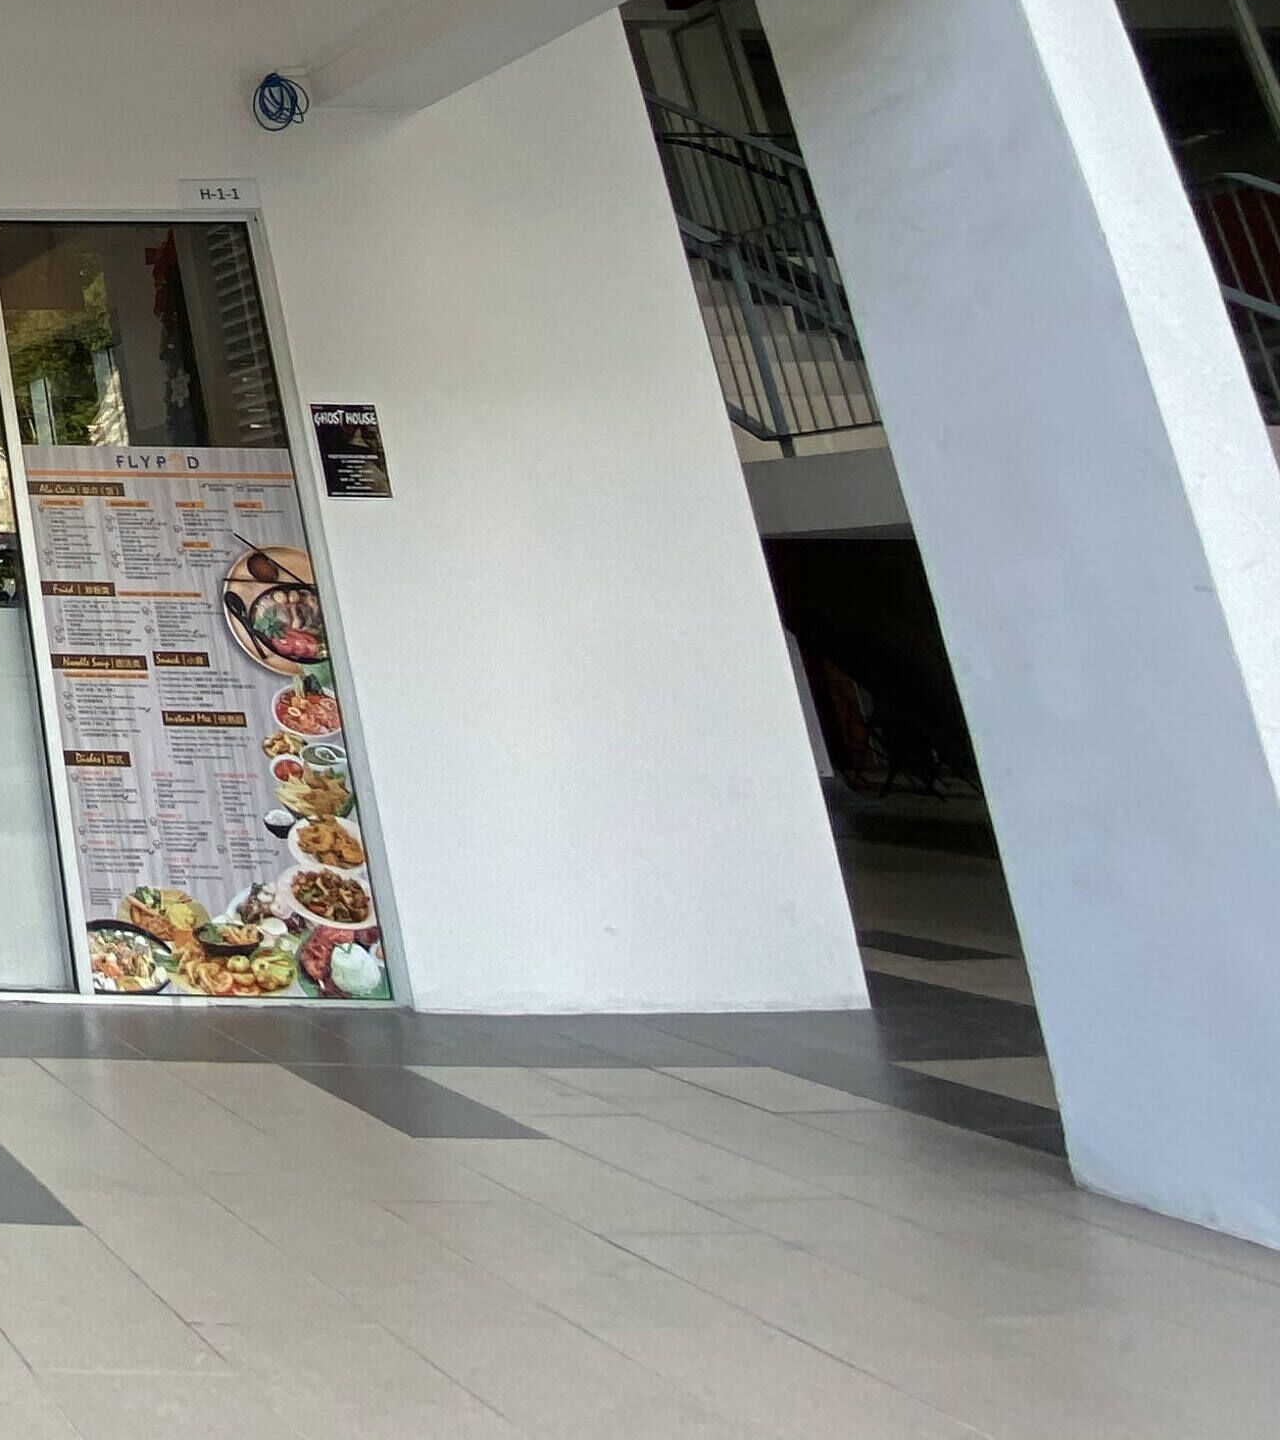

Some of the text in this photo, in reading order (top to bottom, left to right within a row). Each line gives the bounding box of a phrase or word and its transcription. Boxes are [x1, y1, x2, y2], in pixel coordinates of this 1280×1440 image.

[199, 188, 240, 200] H-1-1
[314, 409, 377, 427] GHOST HOUSE
